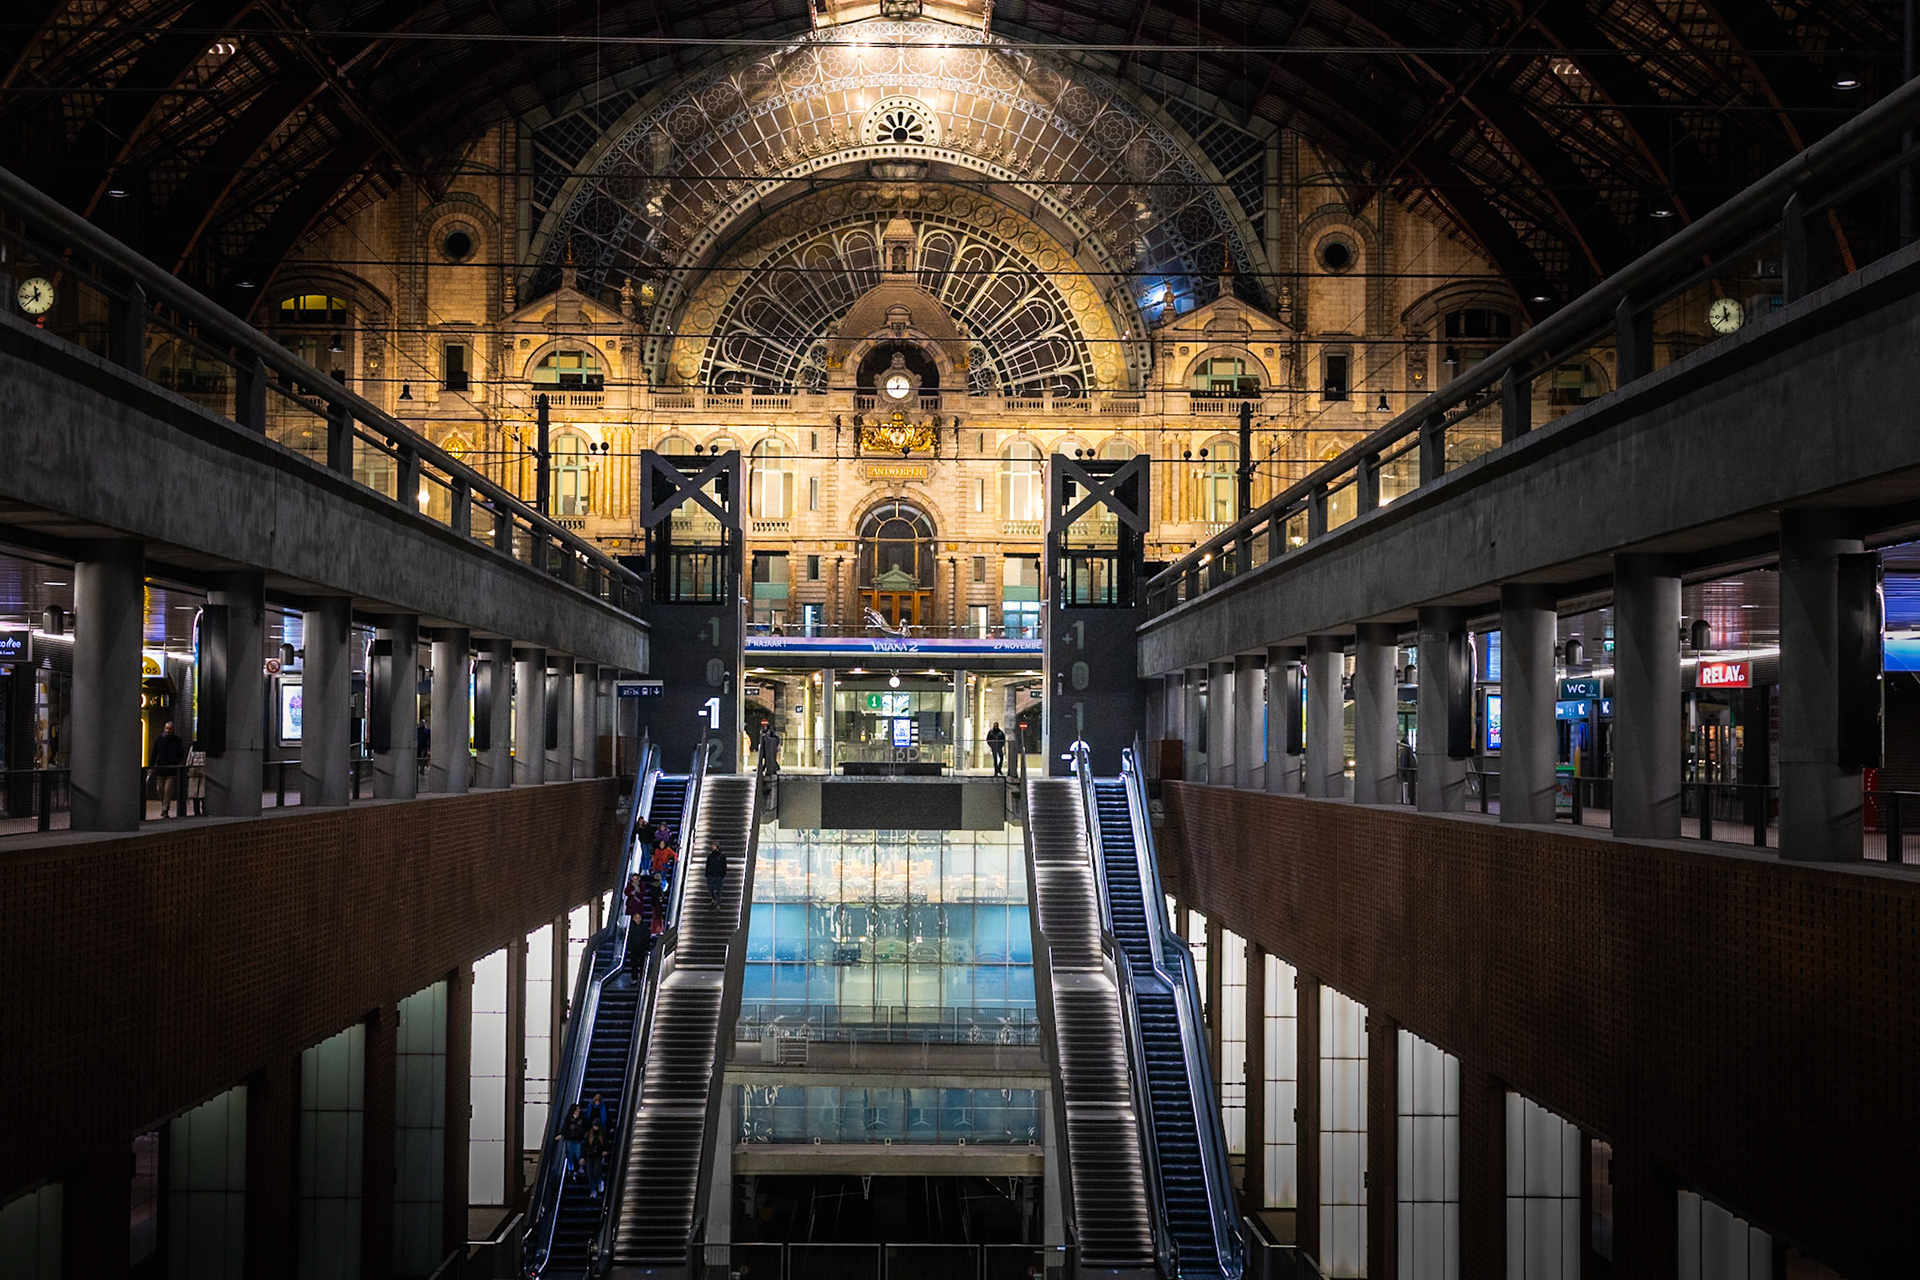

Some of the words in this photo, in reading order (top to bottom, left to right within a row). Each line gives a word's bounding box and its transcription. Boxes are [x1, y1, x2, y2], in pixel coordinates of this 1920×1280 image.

[872, 468, 923, 476] ANTWERPEN
[697, 616, 720, 647] +1
[1061, 619, 1085, 650] +1
[908, 640, 919, 652] 2
[993, 642, 1003, 650] 27
[142, 666, 158, 674] OS
[706, 657, 725, 687] 0
[1071, 660, 1090, 691] 0
[1702, 664, 1741, 685] RELAY
[1566, 683, 1587, 694] WC
[697, 696, 721, 730] -1
[1063, 701, 1085, 731] -1
